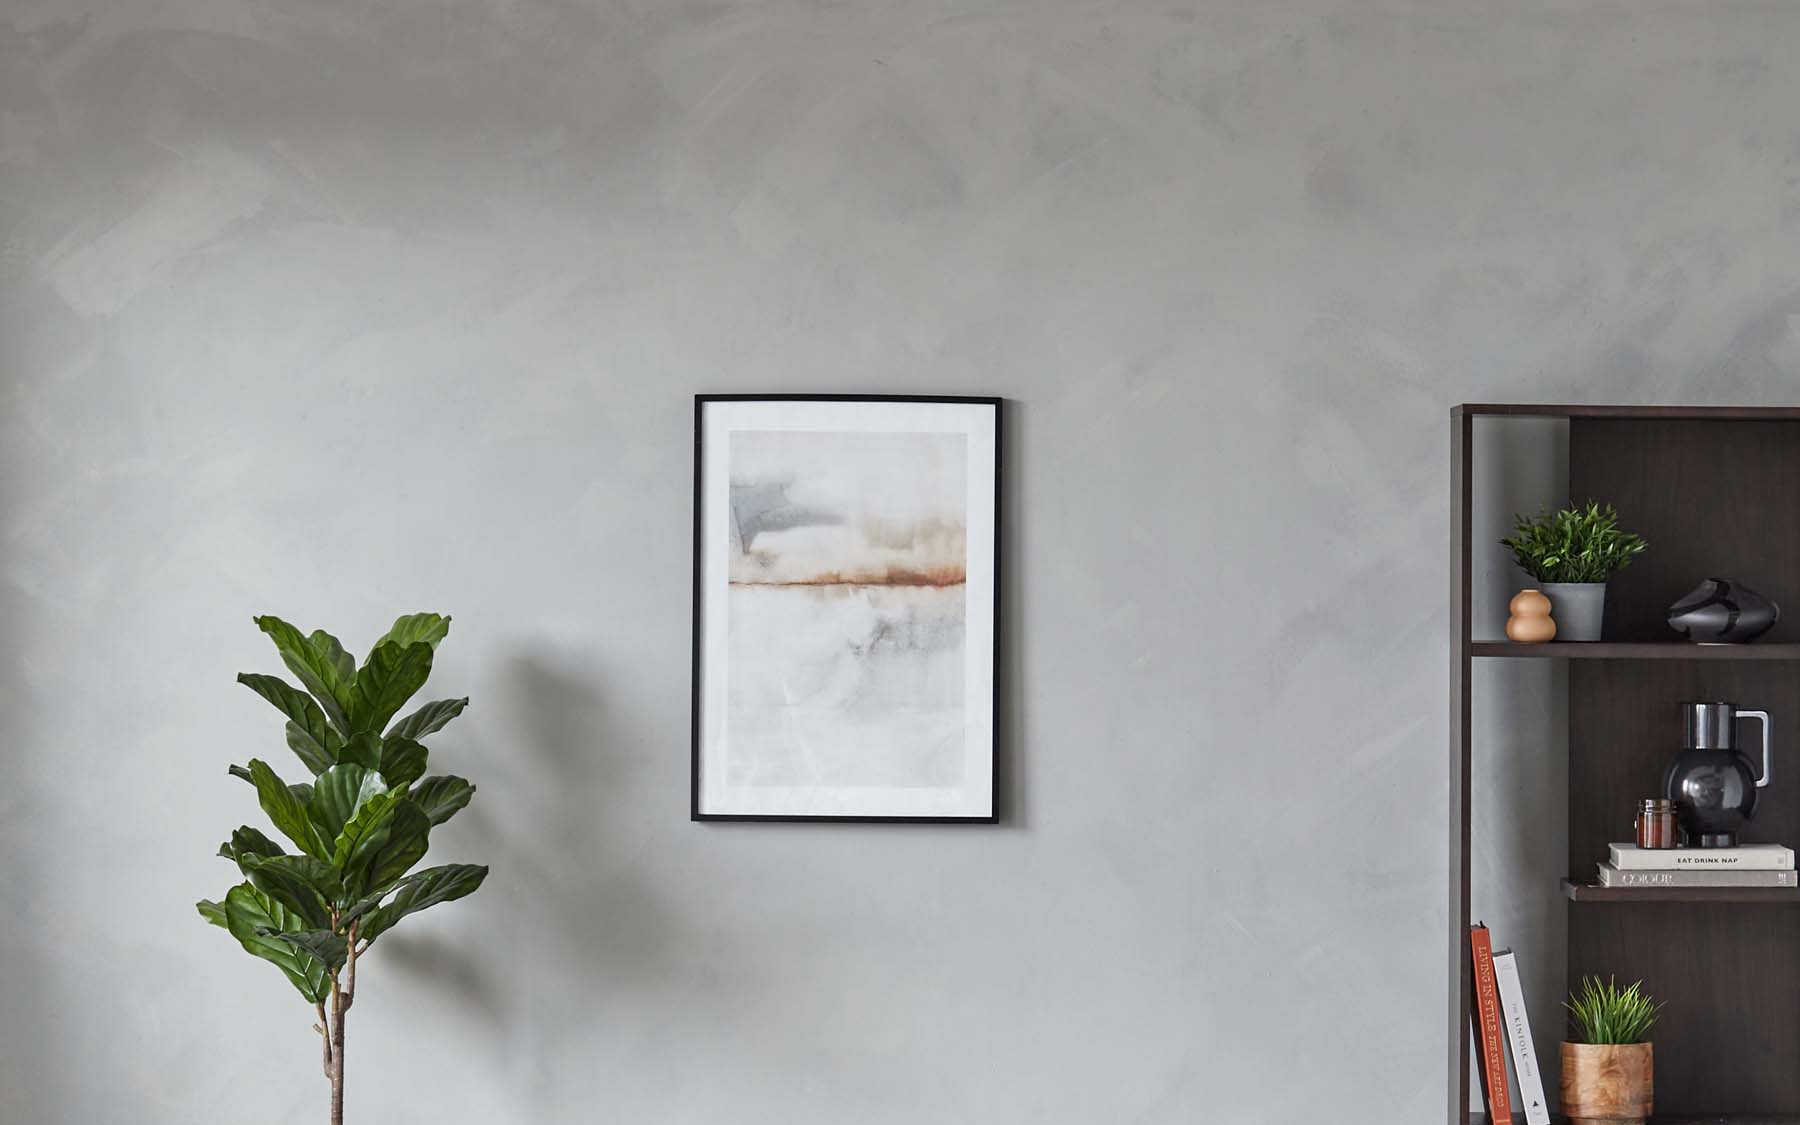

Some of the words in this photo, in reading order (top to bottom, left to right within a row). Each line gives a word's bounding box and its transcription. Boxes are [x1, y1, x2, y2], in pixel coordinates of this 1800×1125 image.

[1479, 946, 1491, 983] LIVING
[1483, 985, 1493, 997] IN
[1485, 999, 1497, 1032] STYLE
[1514, 1017, 1529, 1059] KINFOLK
